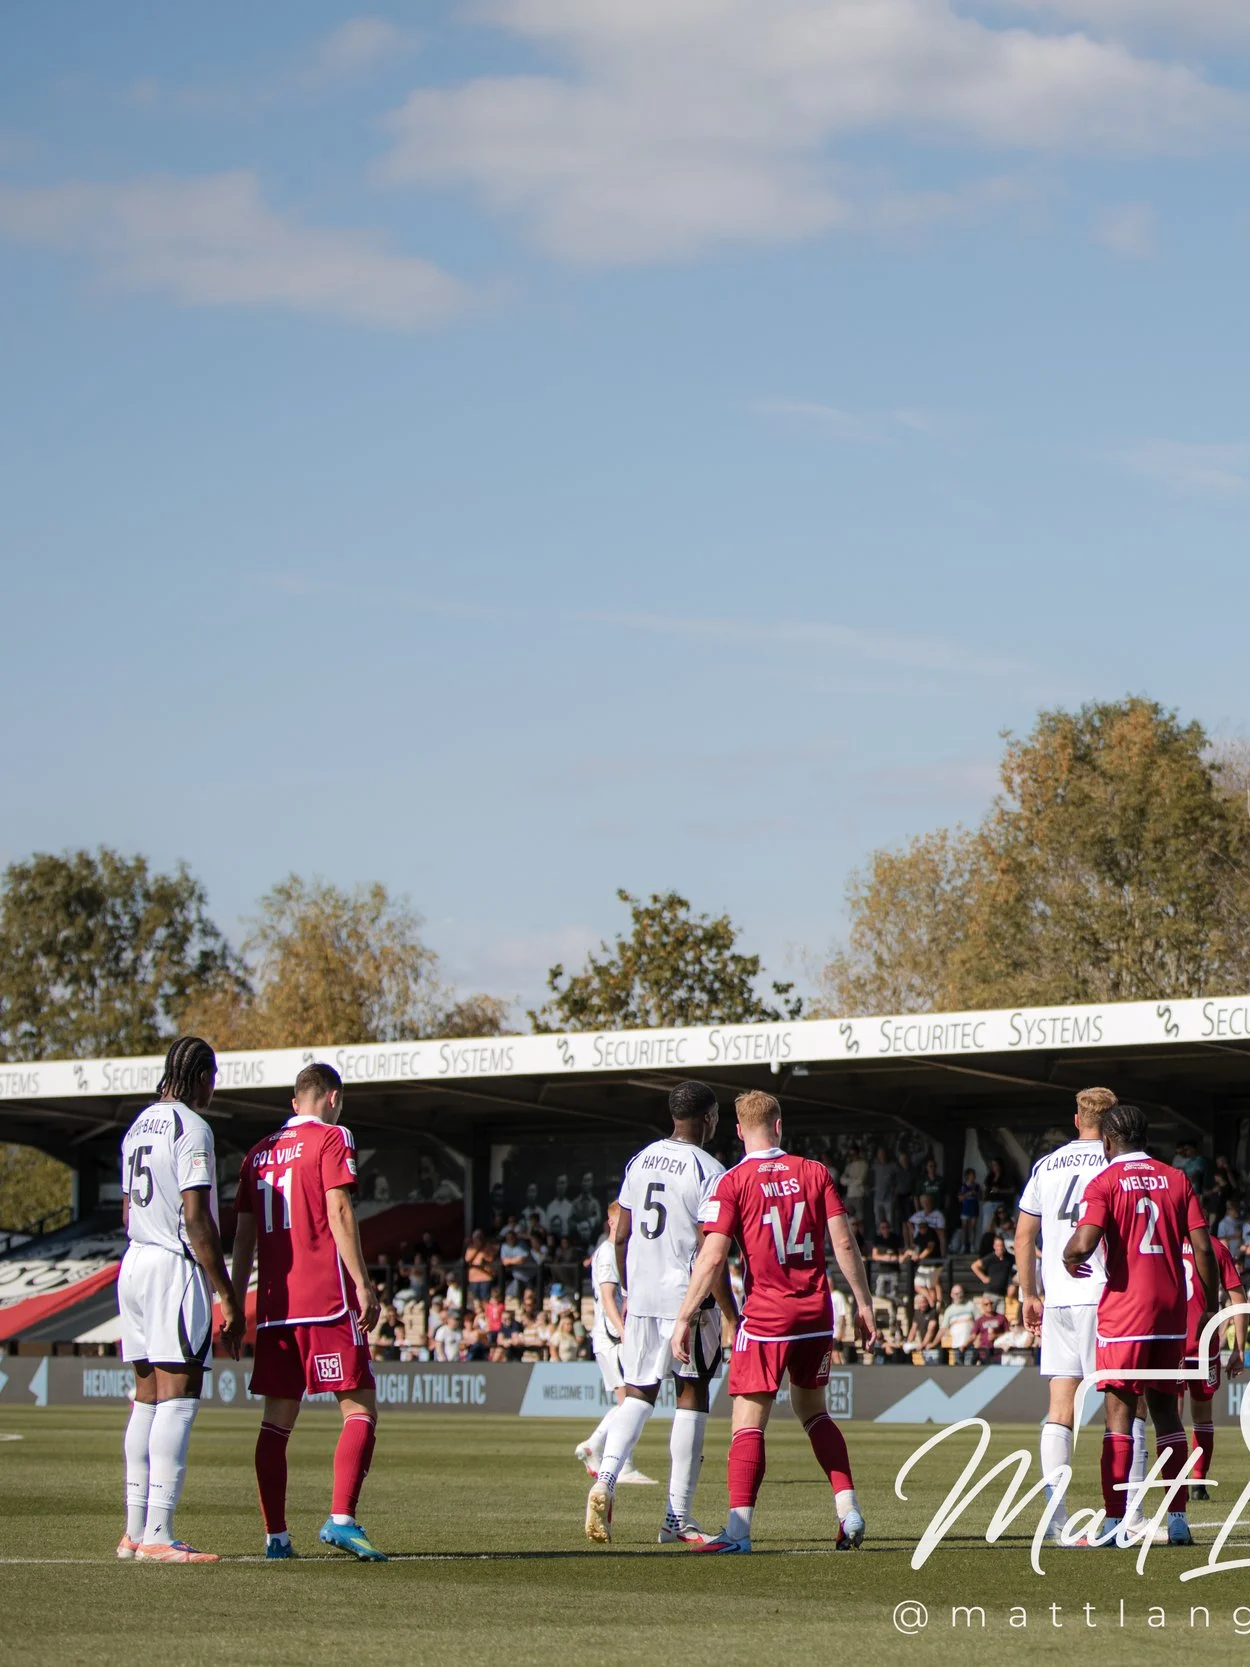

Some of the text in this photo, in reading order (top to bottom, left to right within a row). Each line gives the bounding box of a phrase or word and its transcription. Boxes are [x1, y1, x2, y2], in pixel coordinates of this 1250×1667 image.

[592, 1029, 792, 1067] SECURITEC SYSTEMS
[879, 1013, 1103, 1053] SECURITEC SYSTEMS
[336, 1044, 514, 1079] SECURITEC SYSTEMS
[253, 1142, 304, 1168] COLVILLE
[641, 1155, 687, 1176] HAYDEN
[1046, 1153, 1106, 1172] LANGSTON
[128, 1145, 153, 1208] 15
[760, 1177, 801, 1198] WILES
[1119, 1175, 1169, 1192] WELEDJI
[257, 1167, 293, 1233] 11
[640, 1182, 667, 1240] 5
[762, 1201, 815, 1264] 14
[1135, 1196, 1164, 1254] 2
[318, 1357, 339, 1369] TIG
[321, 1367, 340, 1378] OLI
[411, 1374, 487, 1405] ATHLETIC
[542, 1384, 582, 1400] WELCOME
[584, 1384, 595, 1400] TO
